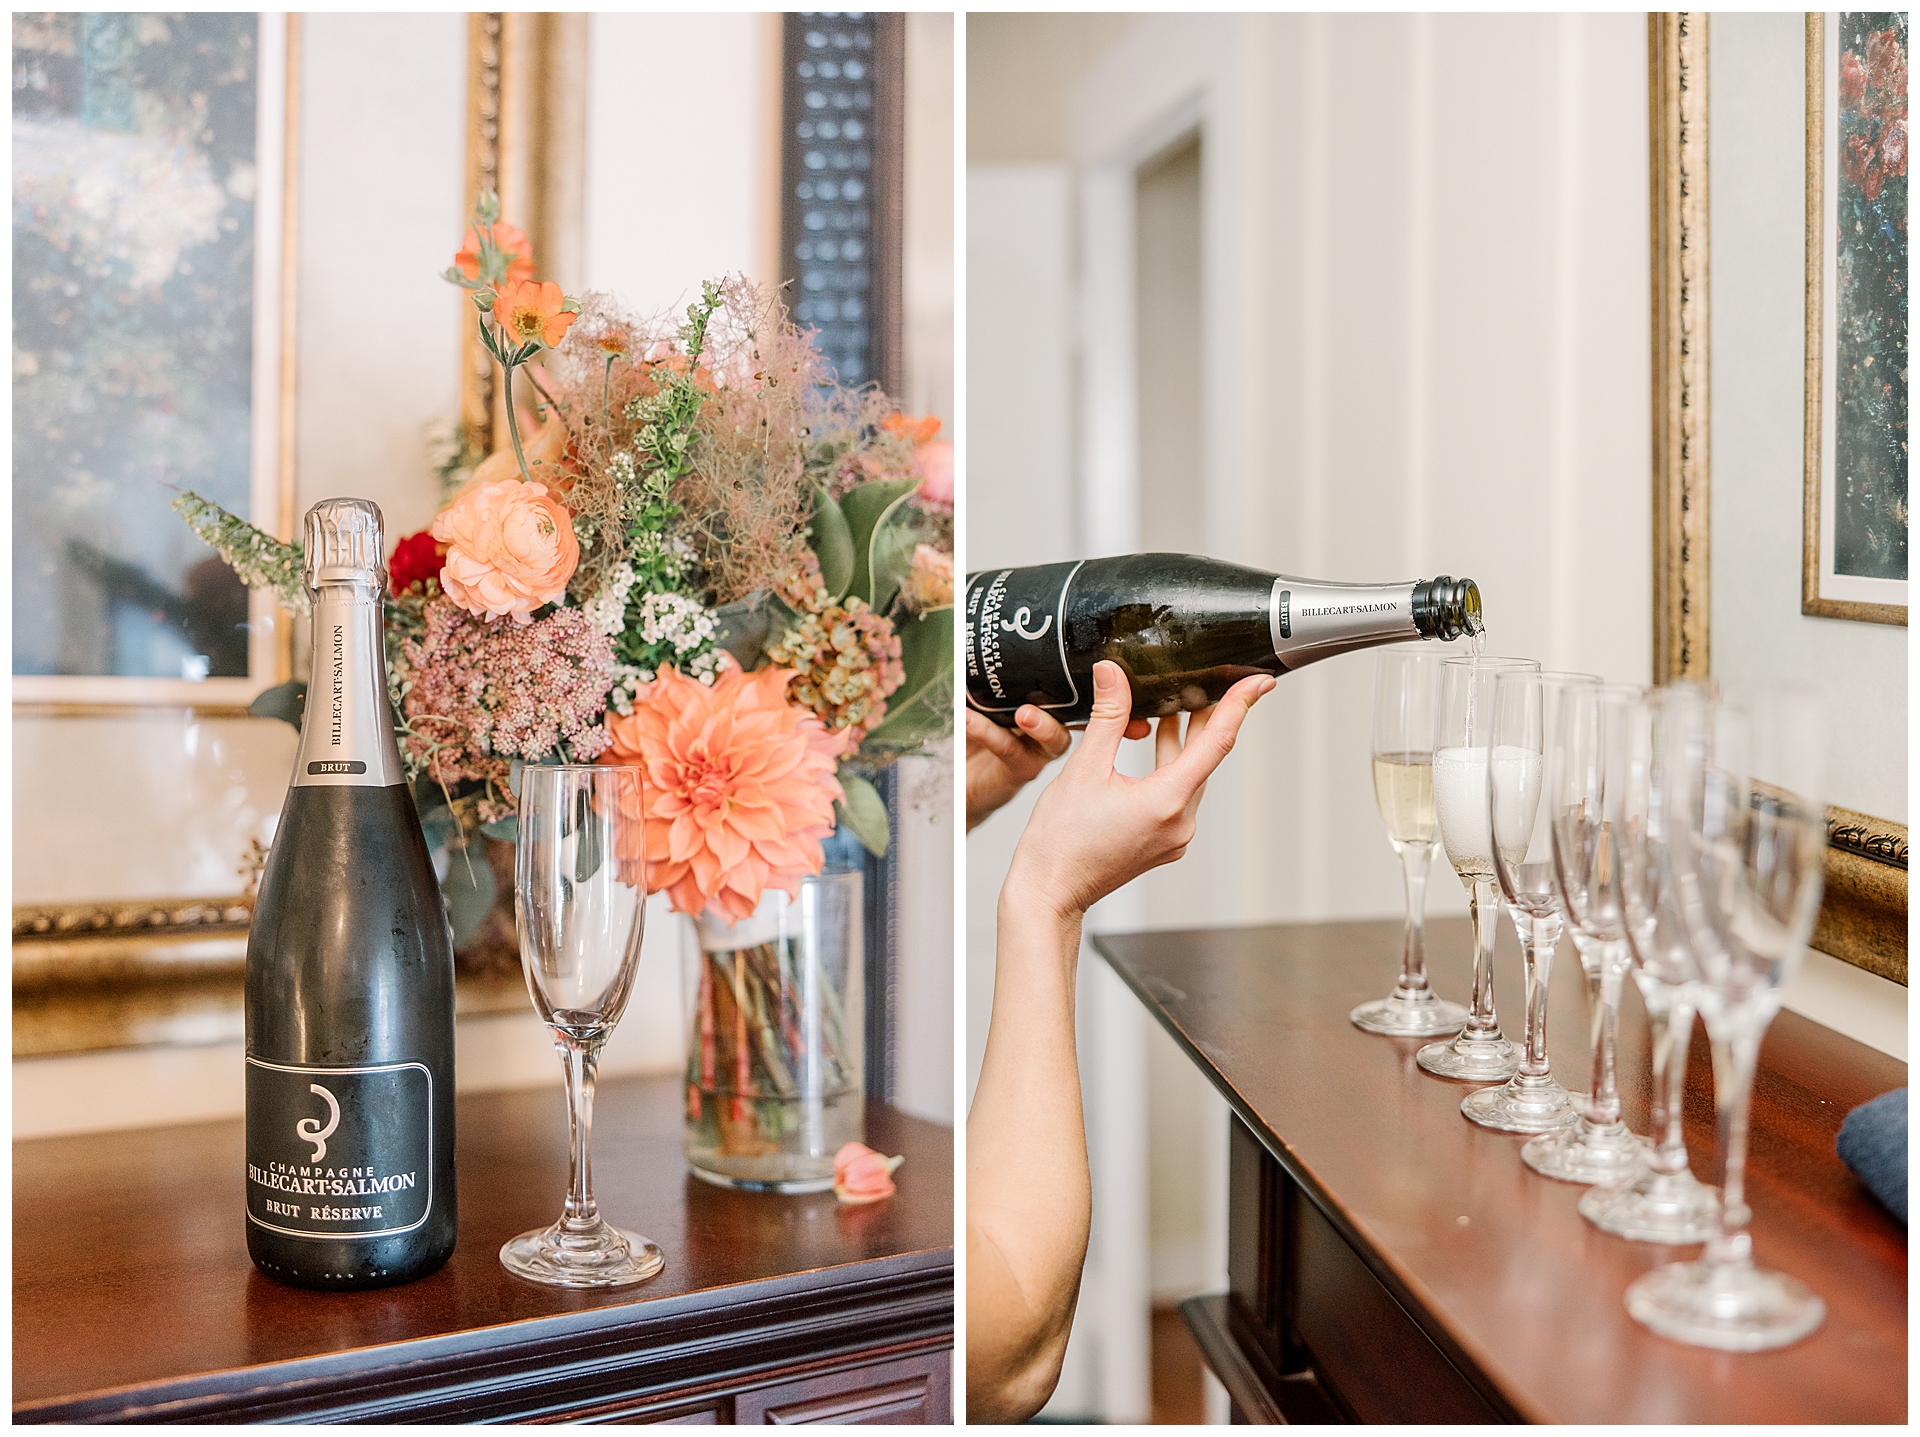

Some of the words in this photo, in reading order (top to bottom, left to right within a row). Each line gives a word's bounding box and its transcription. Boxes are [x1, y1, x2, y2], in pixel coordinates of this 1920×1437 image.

[966, 586, 985, 615] BRUT
[1302, 602, 1397, 617] BILLECART-SALMON
[1280, 601, 1288, 626] BRUT
[991, 587, 1007, 668] CHAMPAGNE
[331, 625, 343, 746] BILLECART-SALMON
[320, 763, 351, 772] BRUT
[248, 1163, 416, 1196] BILLECART-SALMON
[270, 1161, 374, 1178] CHAMPAGNE
[266, 1198, 301, 1218] BRUT
[310, 1204, 383, 1221] RÉSERVE
